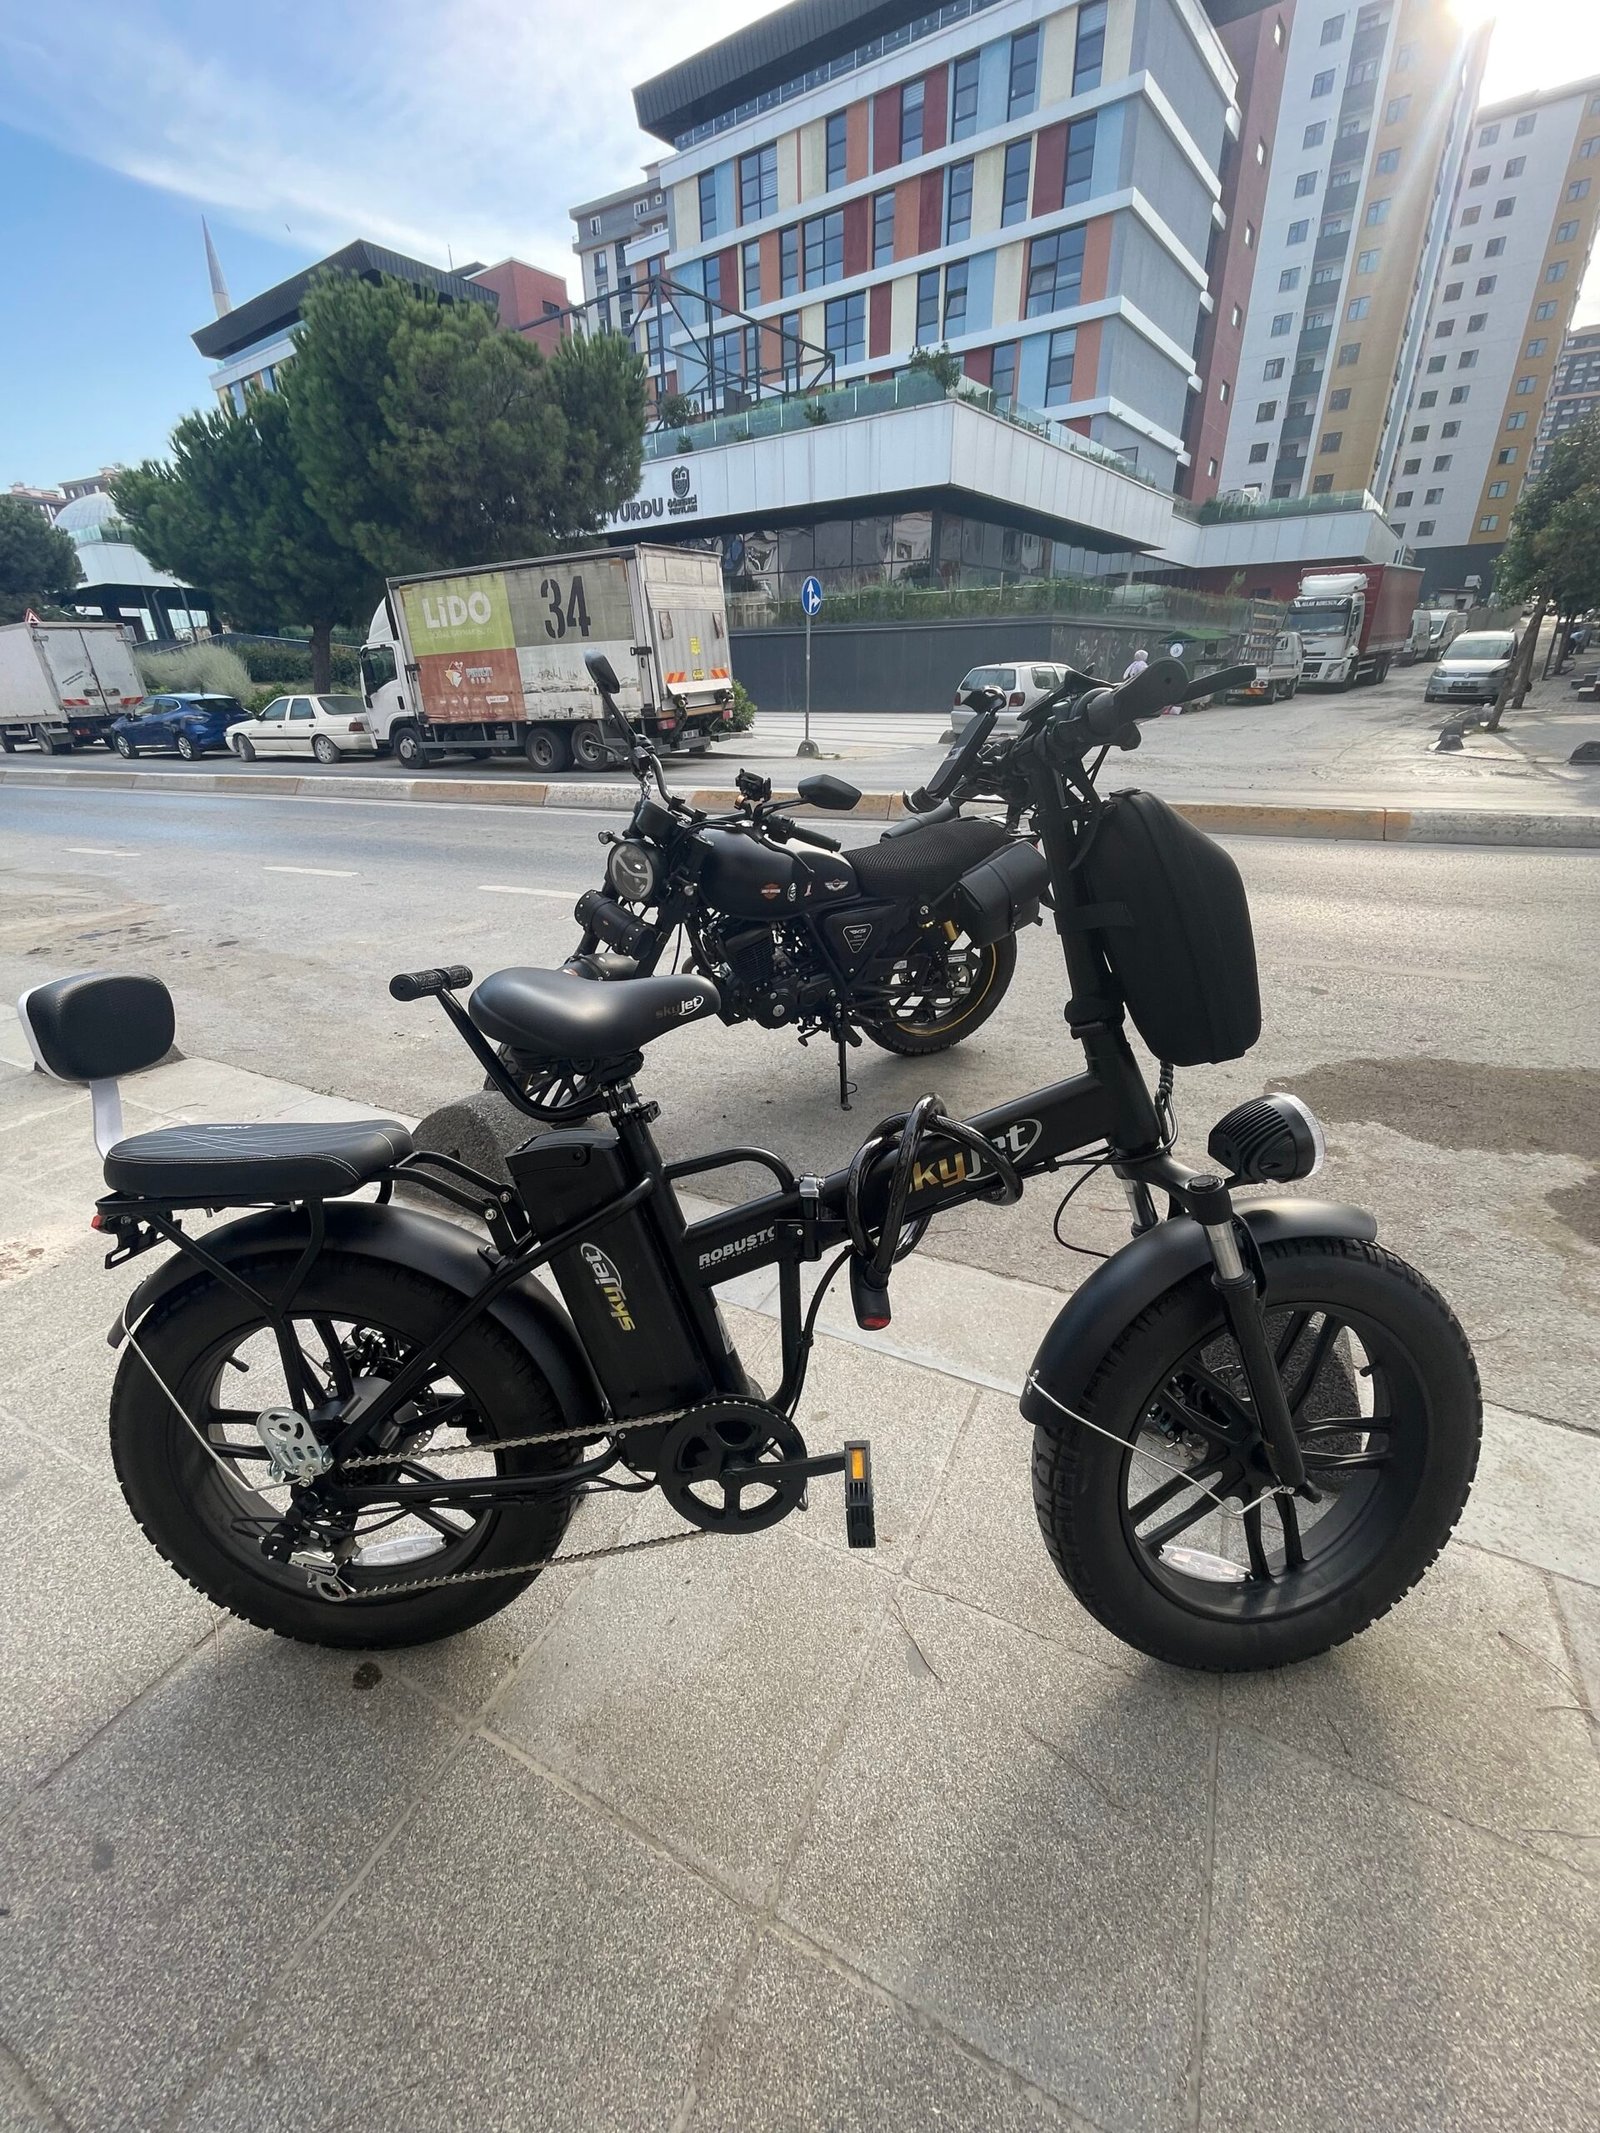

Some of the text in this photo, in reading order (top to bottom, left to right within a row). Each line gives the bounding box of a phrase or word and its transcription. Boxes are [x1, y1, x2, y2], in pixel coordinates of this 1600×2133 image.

[609, 497, 664, 523] YURDU
[541, 576, 591, 638] 34
[580, 1243, 636, 1332] skyjet
